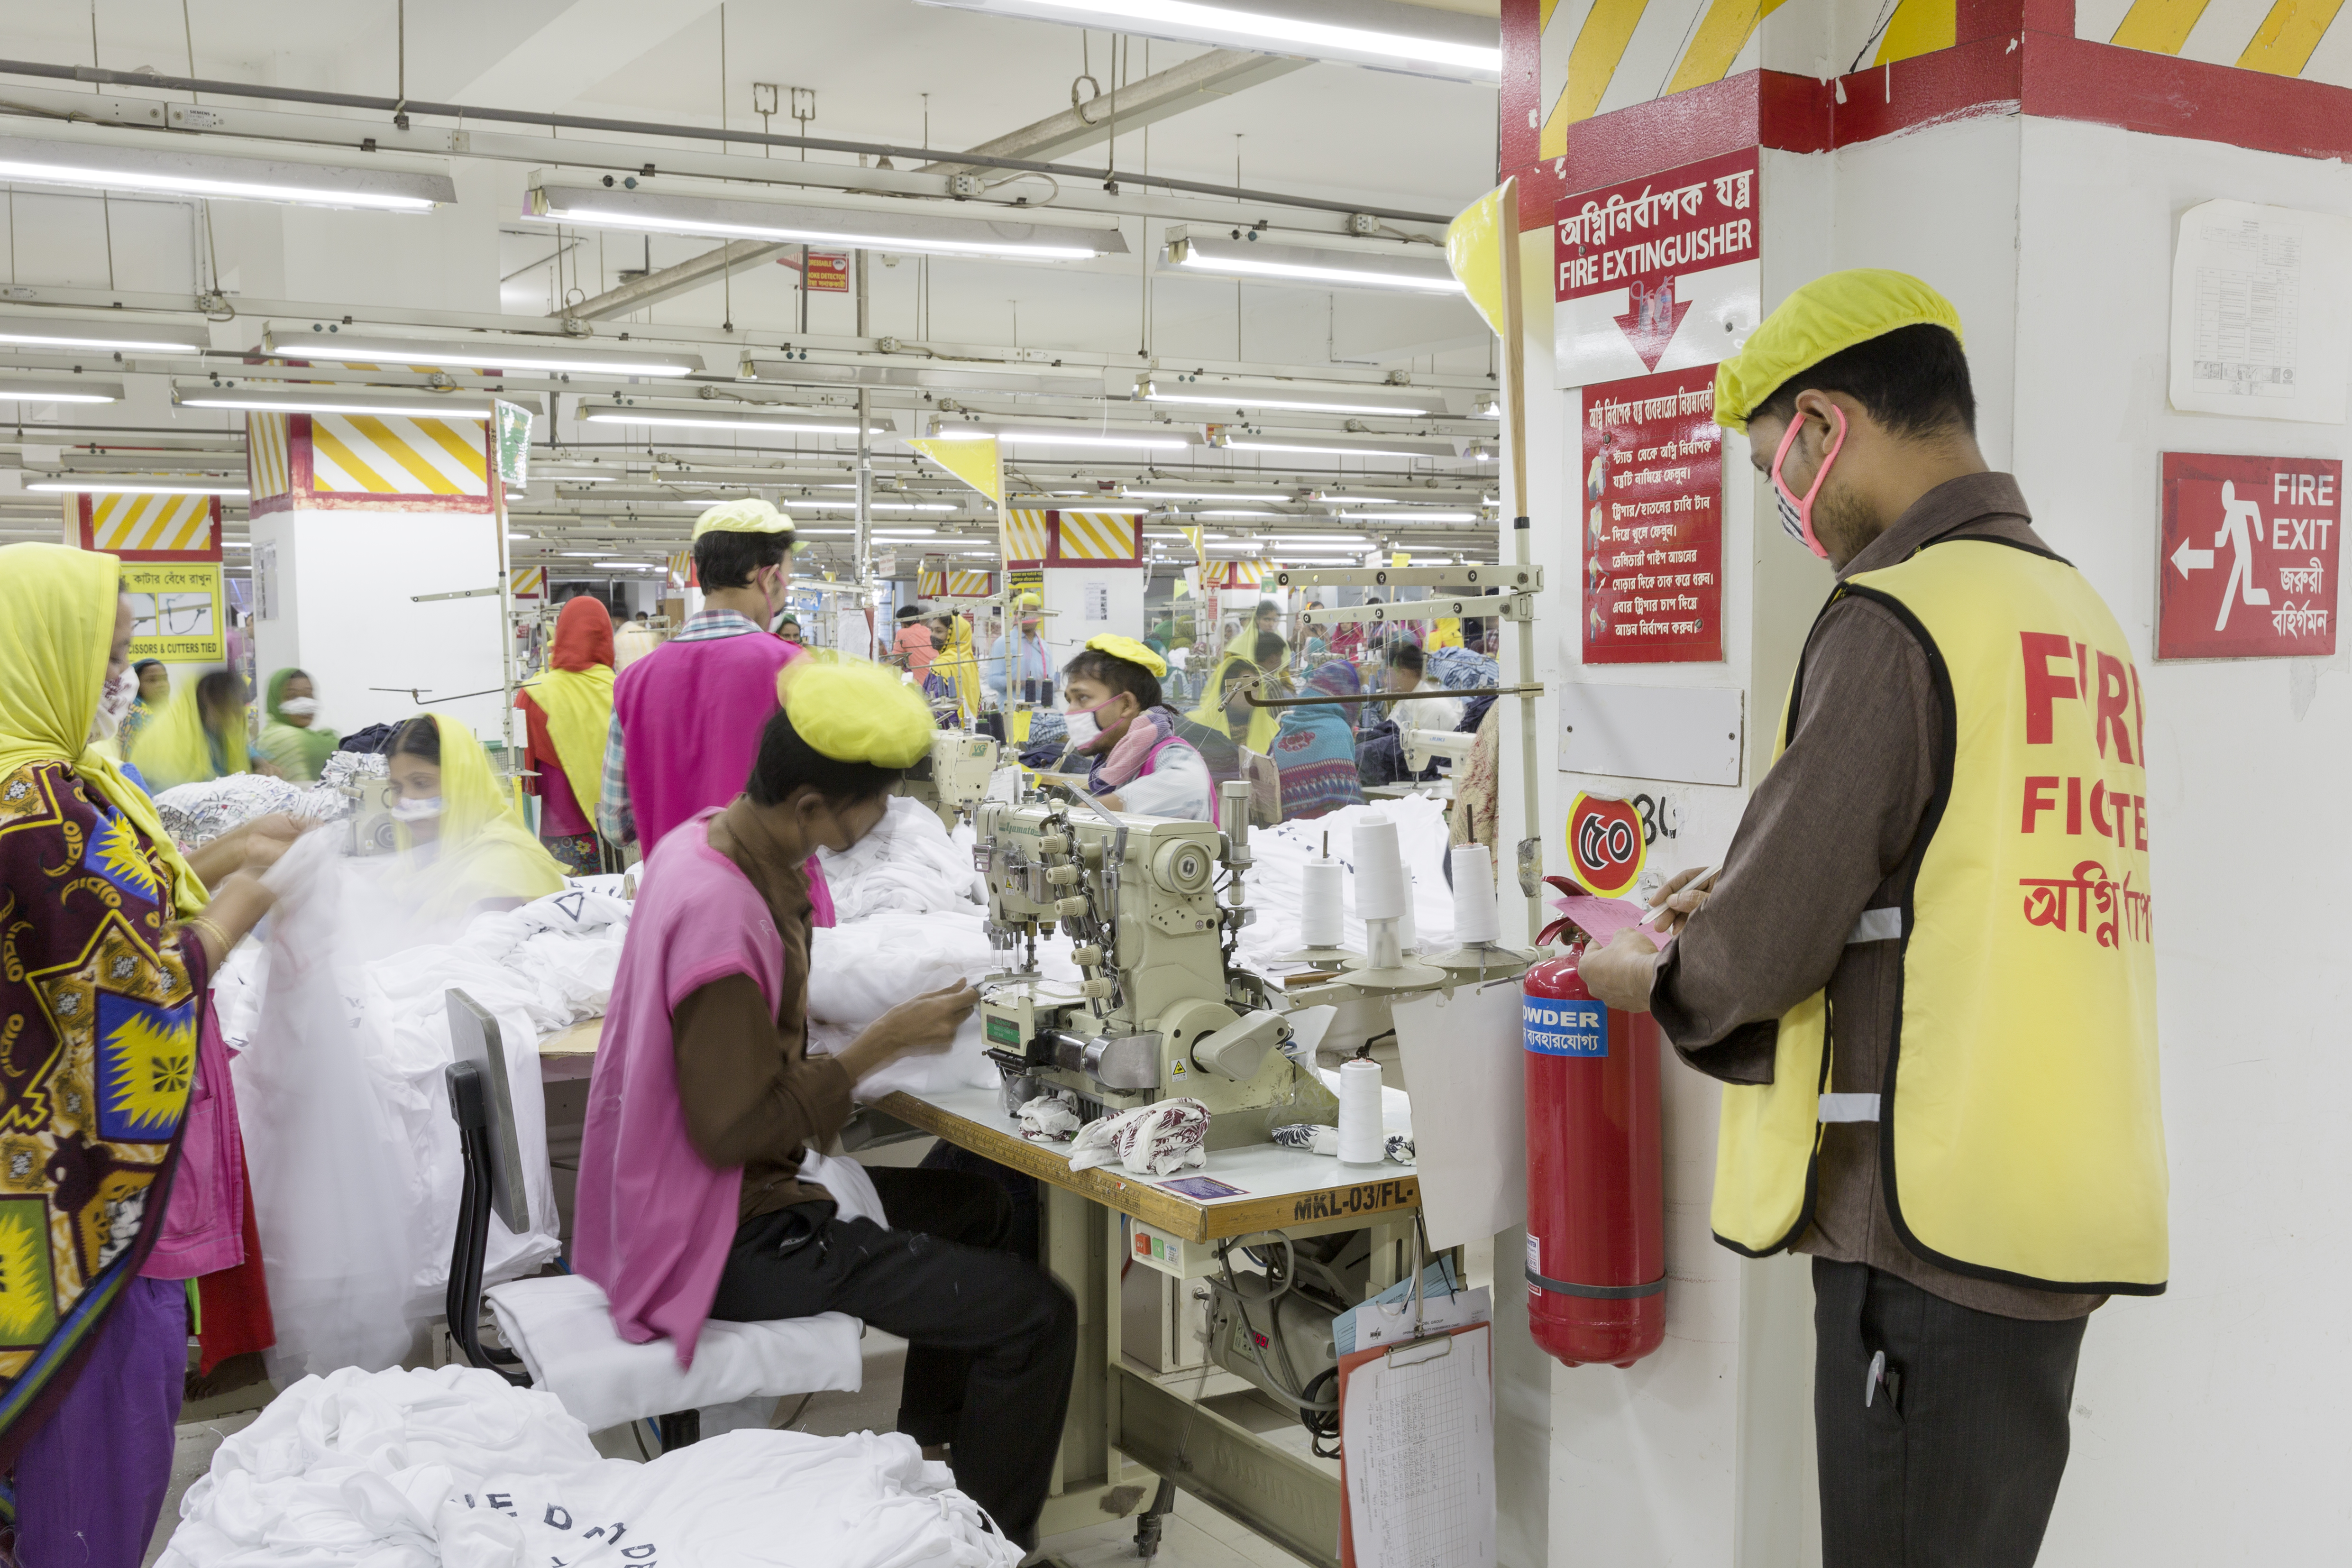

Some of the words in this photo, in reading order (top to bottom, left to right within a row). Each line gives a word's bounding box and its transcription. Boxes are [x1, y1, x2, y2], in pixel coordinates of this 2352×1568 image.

[808, 259, 832, 267] DRESSABLE
[1559, 255, 1598, 291] FIRE
[1603, 219, 1752, 281] EXTINGUISHER
[2274, 473, 2334, 506] FIRE
[2273, 518, 2333, 550] EXIT
[2279, 557, 2324, 595] জরুরী
[2271, 600, 2328, 640] বহির্গমন
[128, 643, 157, 654] CISSORS
[167, 643, 199, 653] CUTTERS
[201, 642, 217, 652] TIED
[1523, 1005, 1600, 1028] OWDER
[1527, 1029, 1599, 1051] ব্যবহারযোগ্য
